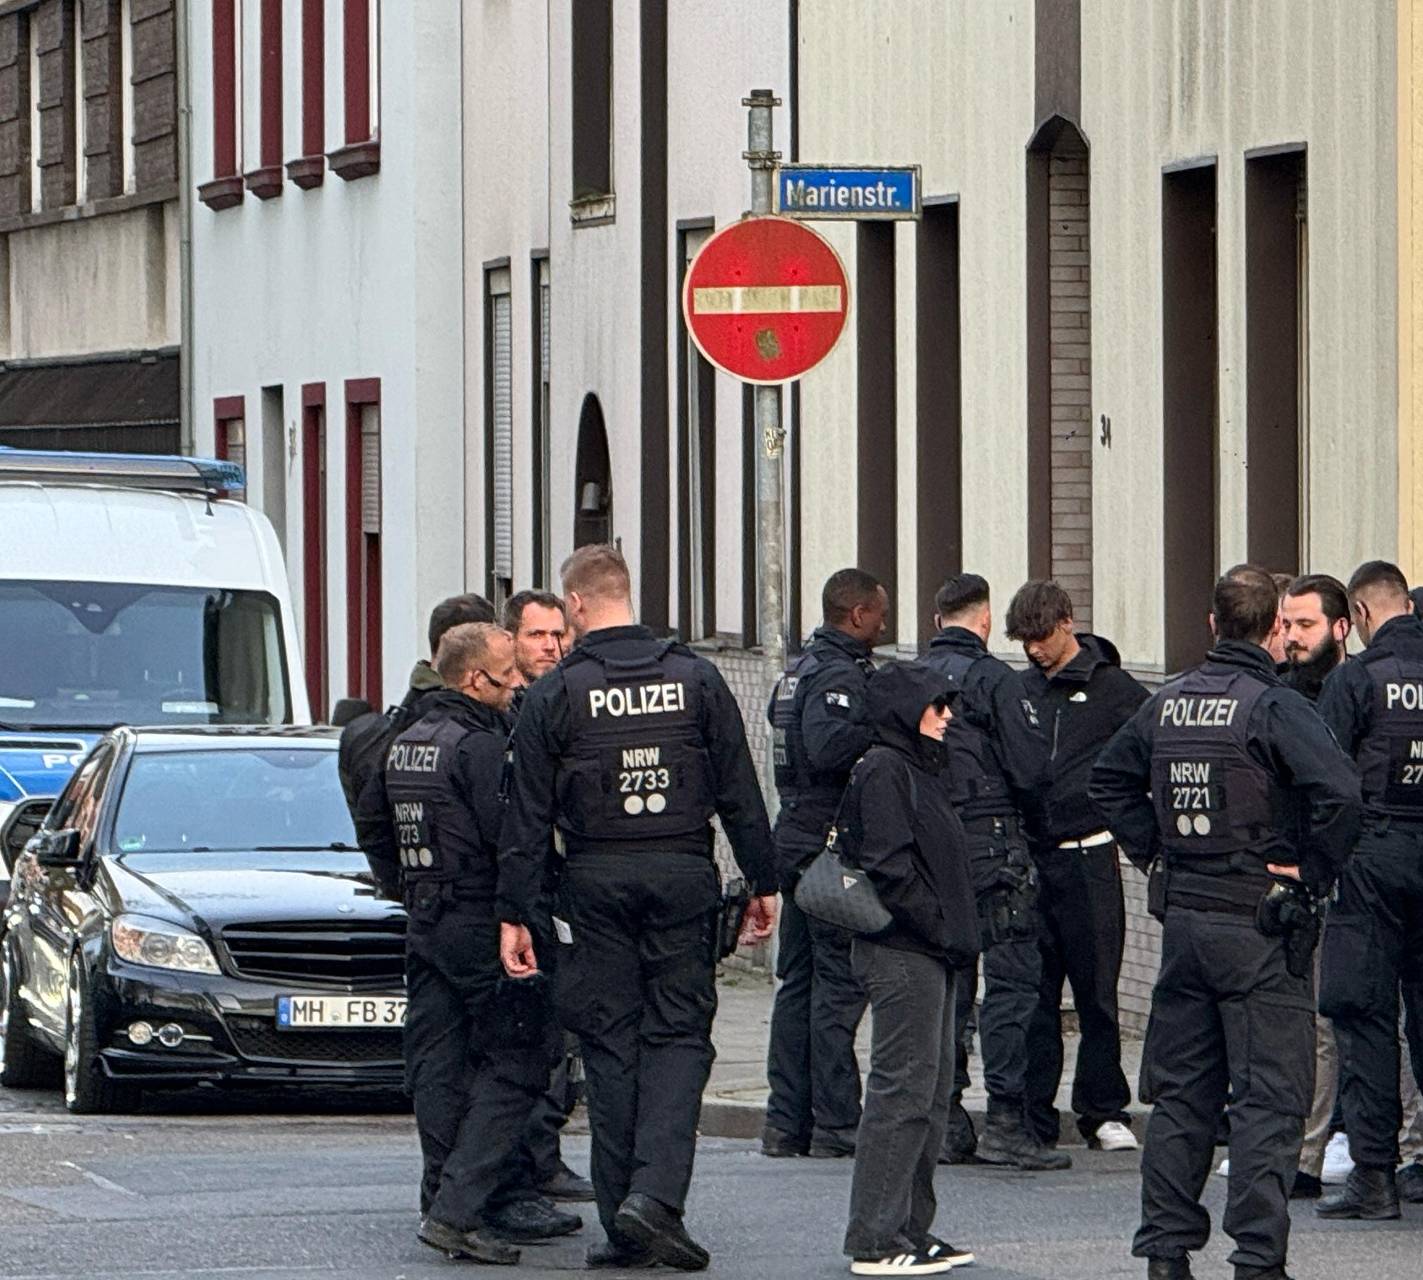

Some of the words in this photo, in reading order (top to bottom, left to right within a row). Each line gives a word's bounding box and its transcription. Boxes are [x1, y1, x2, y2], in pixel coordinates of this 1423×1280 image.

[786, 178, 900, 207] Marienstr.
[1100, 413, 1111, 449] 34
[589, 682, 685, 718] POLIZEI
[1159, 698, 1239, 727] POLIZEI
[386, 744, 441, 772] POLIZEI
[622, 747, 660, 769] NRW
[619, 768, 670, 793] 2733
[1170, 762, 1211, 784] NRW
[1172, 786, 1211, 809] 2721
[394, 802, 424, 822] NRW
[292, 1000, 324, 1023] MH
